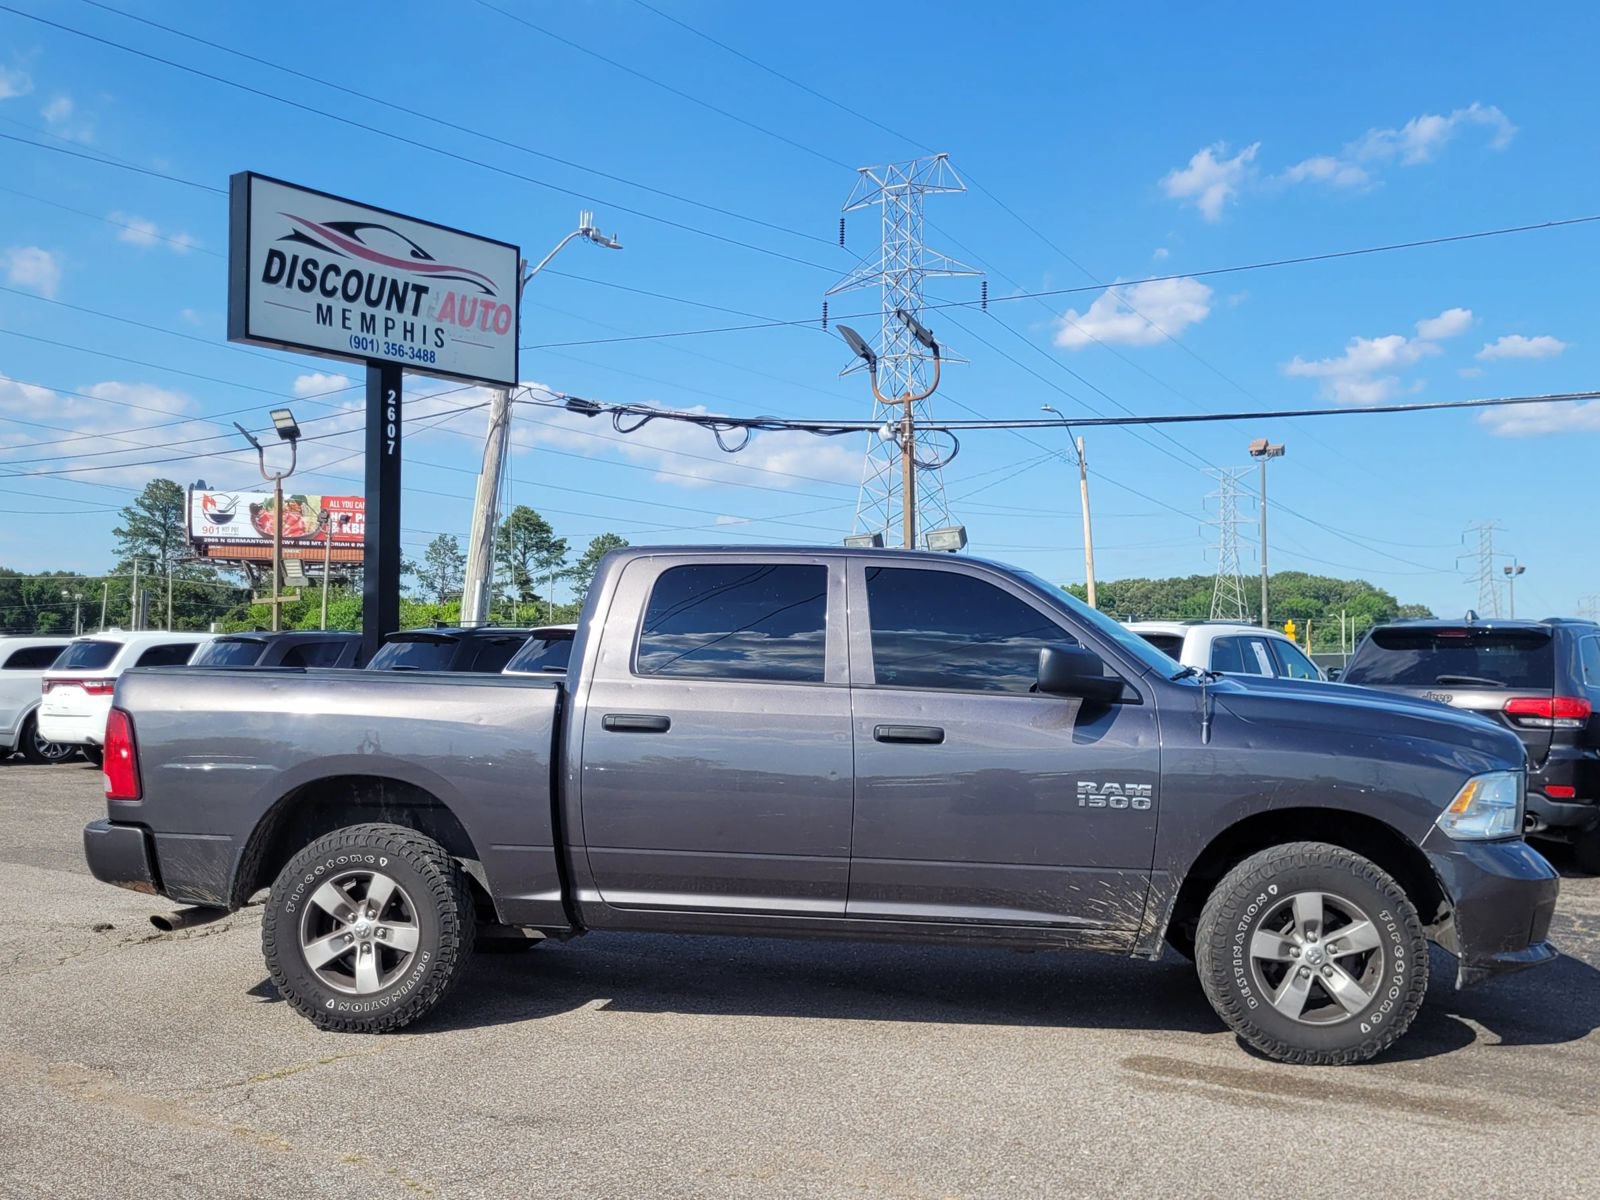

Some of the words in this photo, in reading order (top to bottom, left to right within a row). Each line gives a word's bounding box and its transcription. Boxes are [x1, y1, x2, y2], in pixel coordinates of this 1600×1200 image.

[261, 248, 429, 317] DISCOUNT
[437, 290, 512, 336] AUTO
[316, 303, 445, 349] MEMPHIS
[349, 334, 380, 354] (901)
[383, 341, 436, 364] 356-3488
[387, 389, 396, 455] 2607
[329, 500, 340, 508] ALL
[342, 500, 353, 508] YOU
[201, 525, 220, 535] 901
[1077, 781, 1152, 796] RAM
[1077, 794, 1151, 810] 1500
[1233, 892, 1268, 1009] DESTINATION
[338, 951, 431, 1012] DESTINATION
